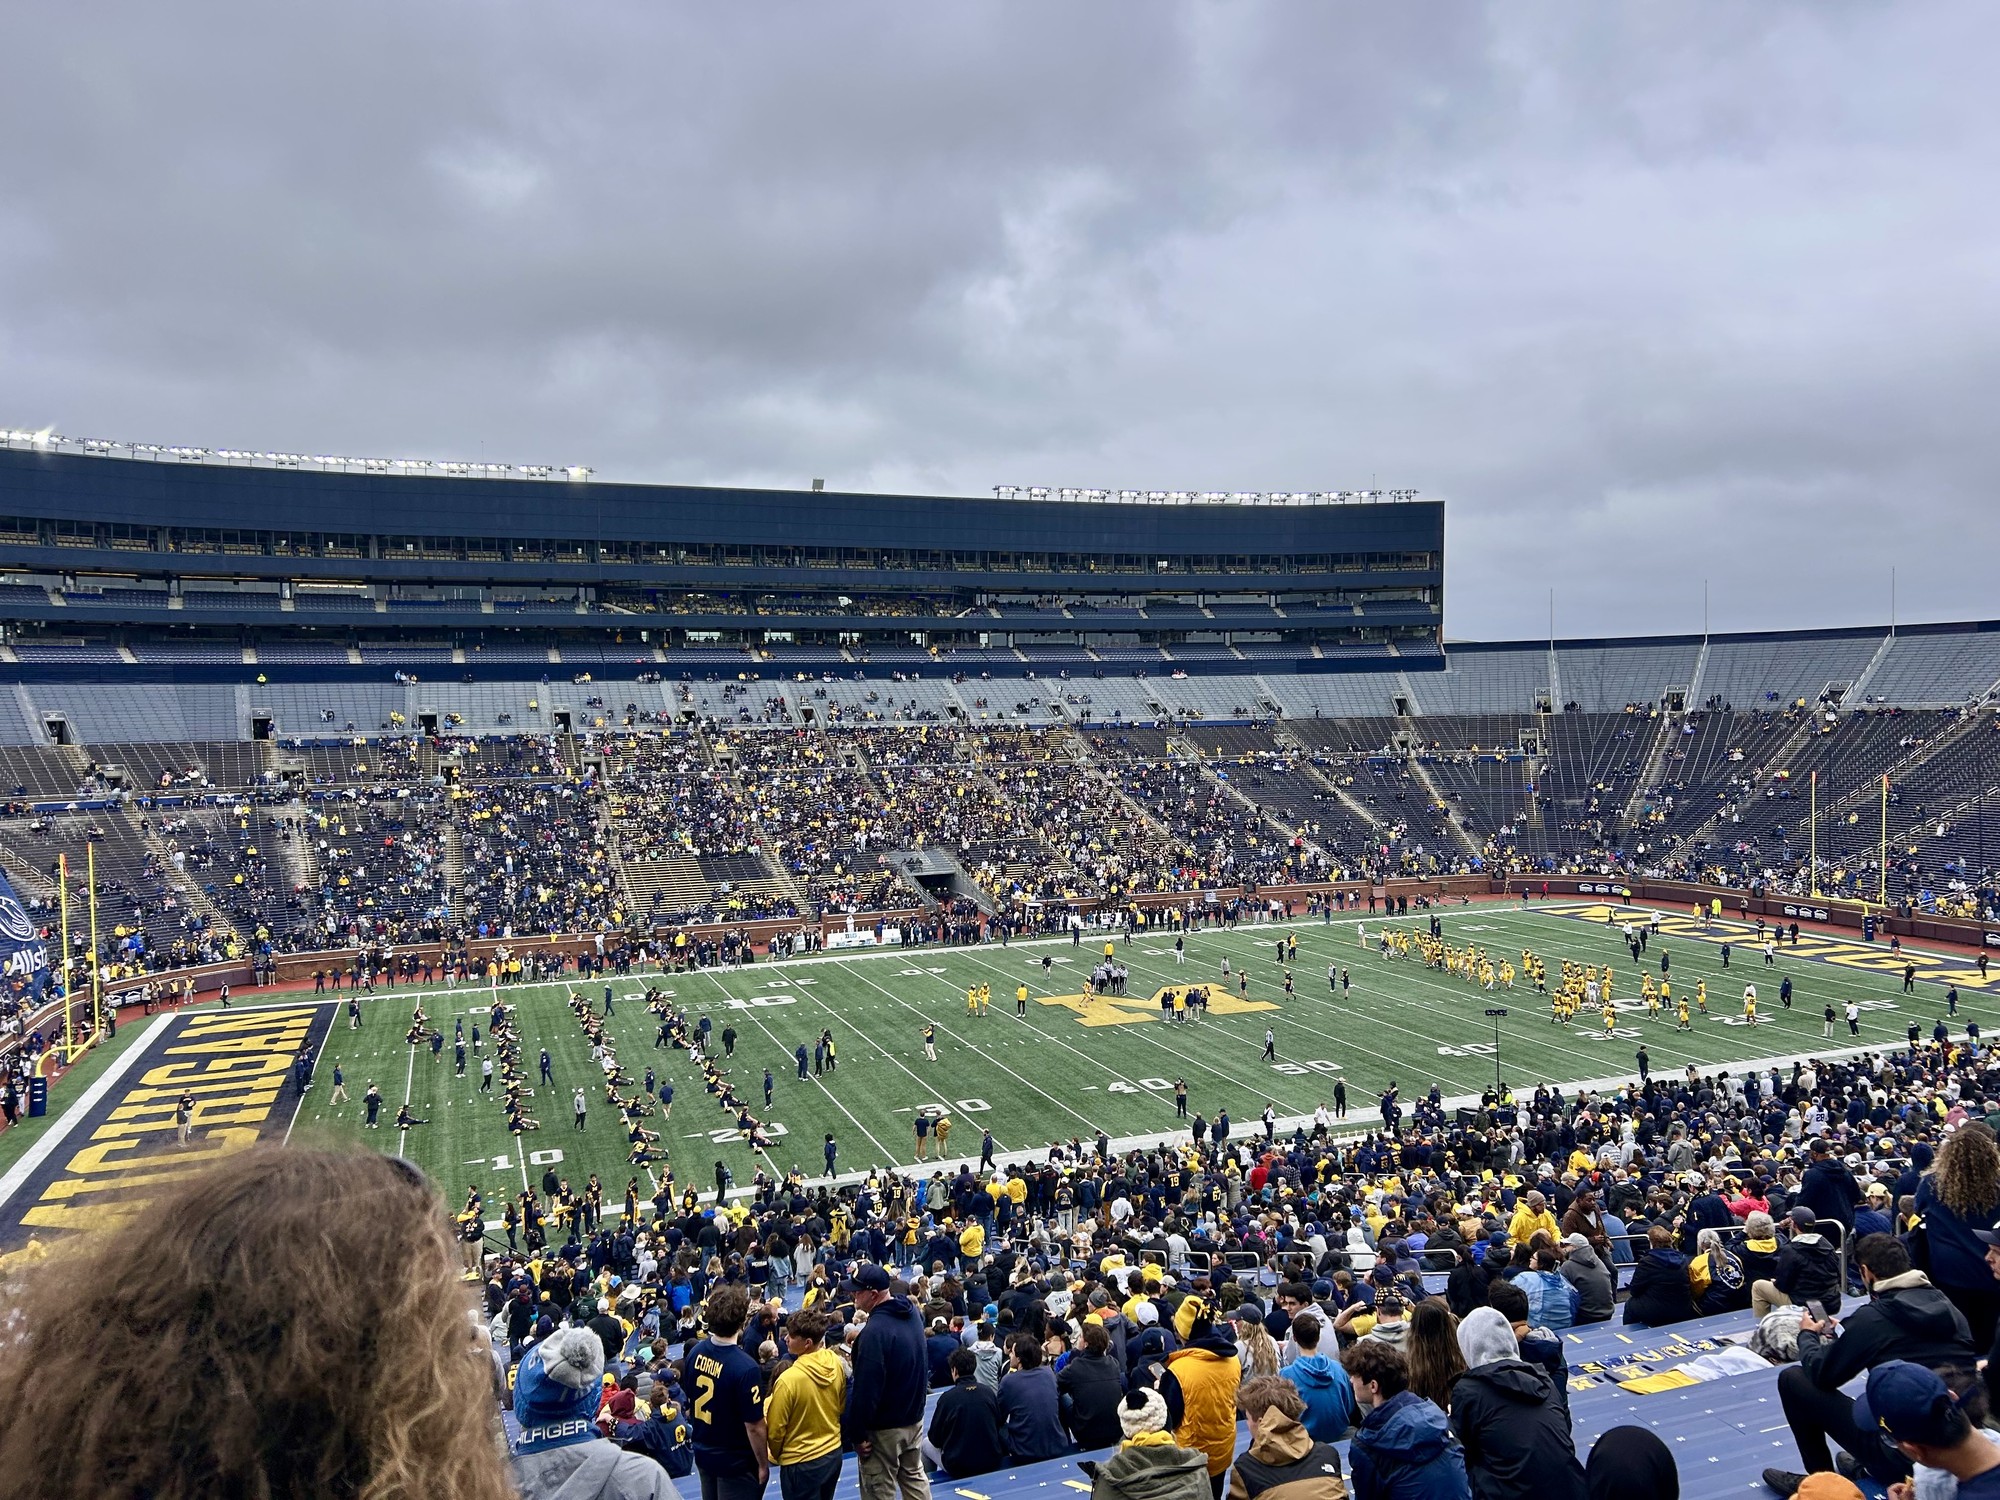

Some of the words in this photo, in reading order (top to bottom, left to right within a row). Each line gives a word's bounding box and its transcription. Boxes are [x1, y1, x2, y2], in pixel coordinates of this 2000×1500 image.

[1541, 903, 2000, 994] MICHIGA
[1437, 1042, 1498, 1057] 40
[1270, 1060, 1343, 1075] 50
[1107, 1077, 1175, 1094] 40
[915, 1098, 993, 1117] 30
[491, 1148, 564, 1171] 10
[694, 1353, 724, 1379] CORUM
[694, 1374, 715, 1425] 2
[750, 1385, 761, 1404] 2
